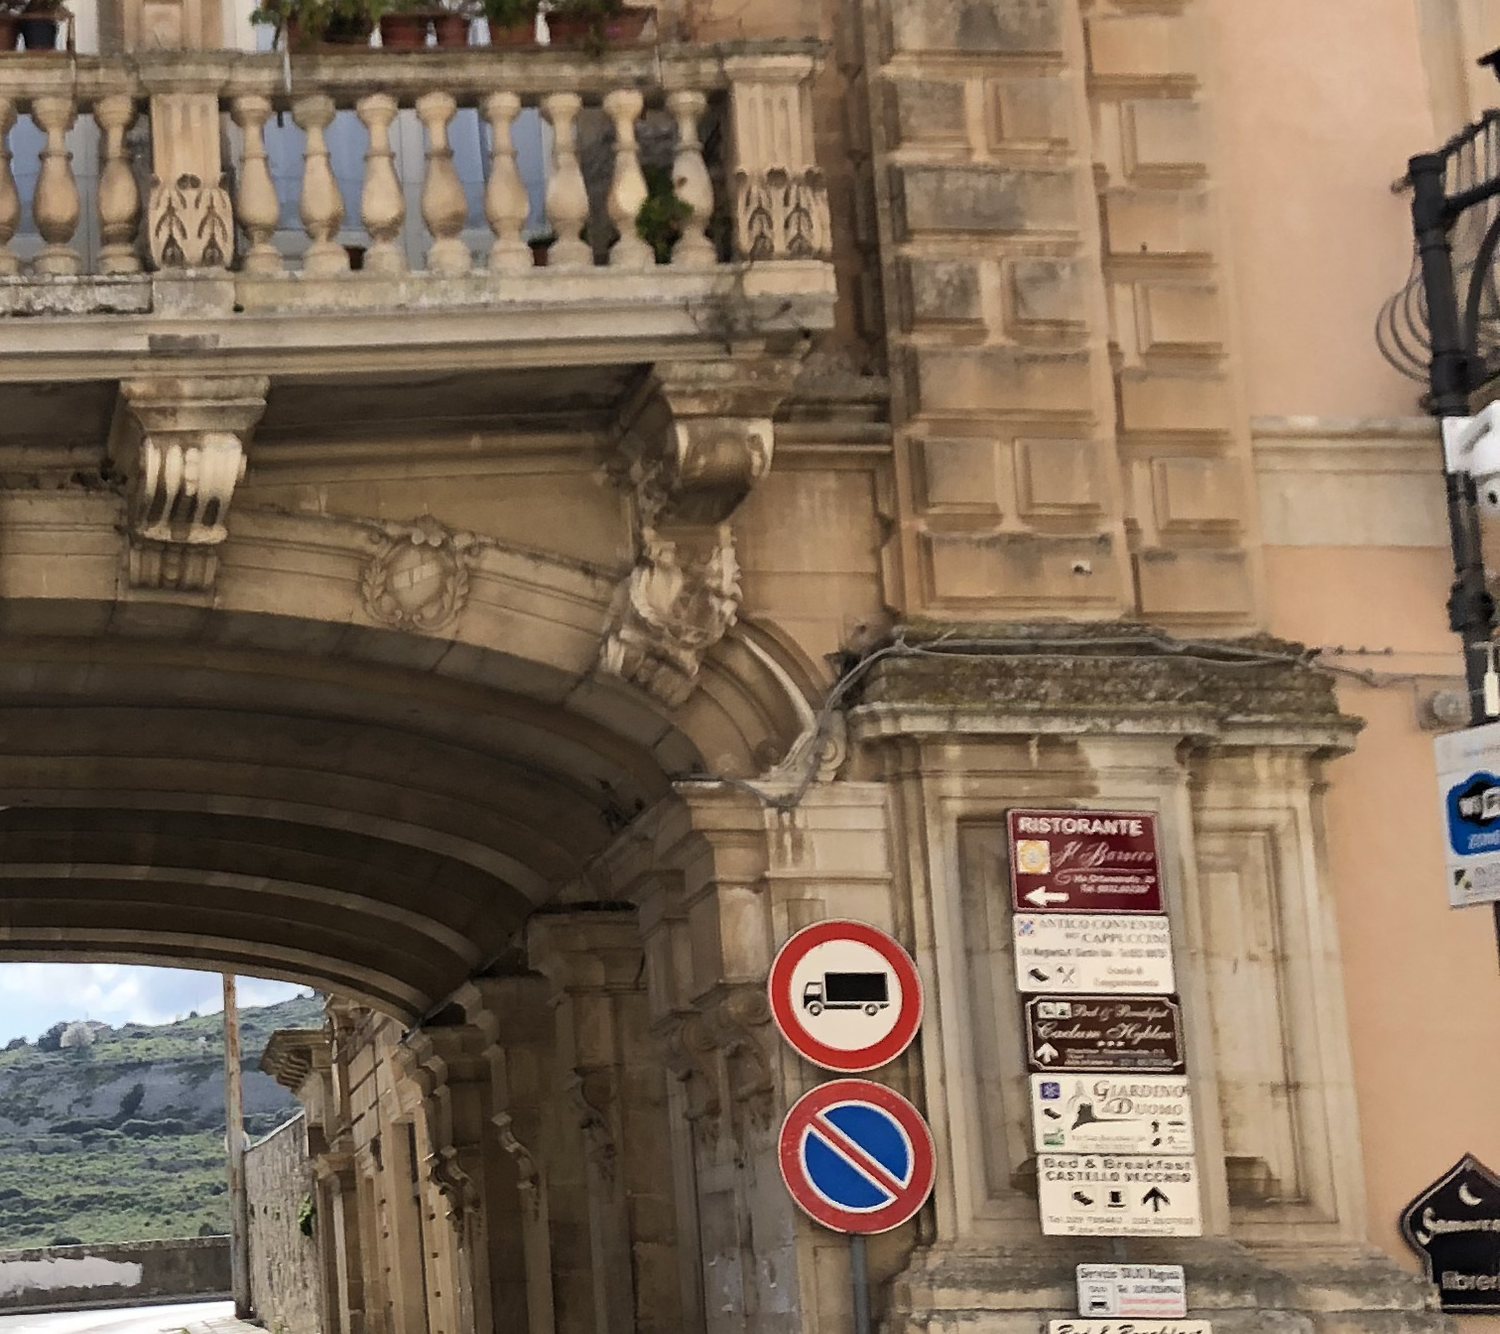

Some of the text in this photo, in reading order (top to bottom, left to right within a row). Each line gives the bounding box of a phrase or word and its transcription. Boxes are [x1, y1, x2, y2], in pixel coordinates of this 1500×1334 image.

[1018, 816, 1143, 837] RISTORANTE
[1093, 1079, 1187, 1102] GIARDINO
[1043, 1157, 1191, 1170] Bed & Breakfast
